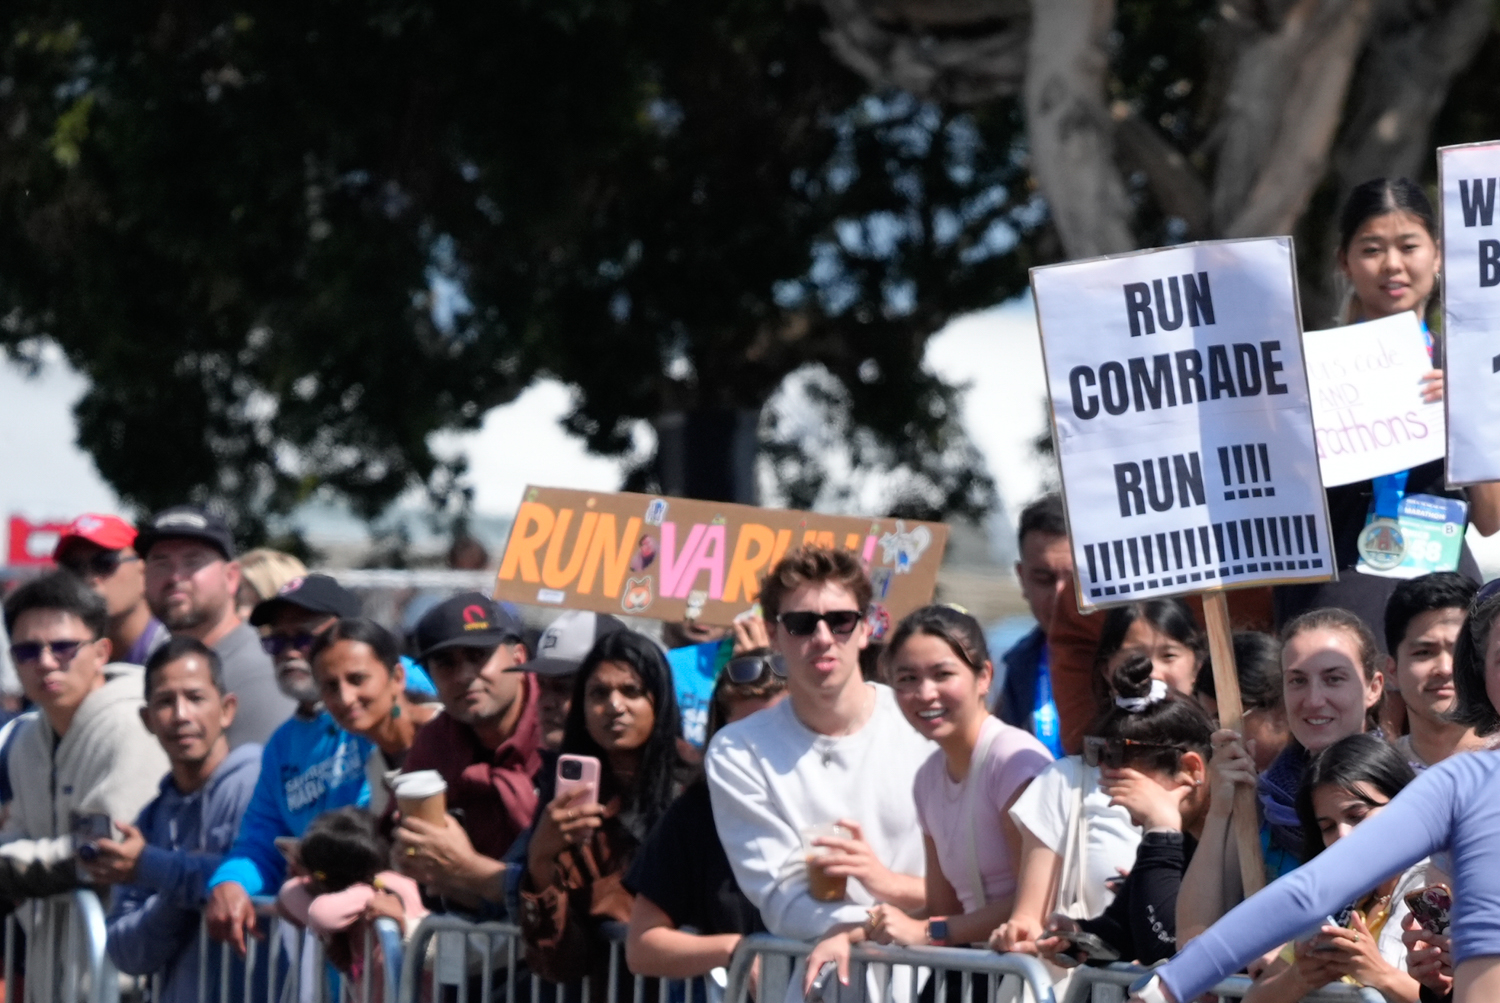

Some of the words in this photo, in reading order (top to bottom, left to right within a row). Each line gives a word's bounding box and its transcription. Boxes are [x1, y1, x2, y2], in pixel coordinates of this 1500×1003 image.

[1123, 271, 1216, 338] RUN
[1068, 340, 1289, 420] COMRADE
[1354, 338, 1404, 373] code
[1318, 383, 1361, 410] AND
[1113, 451, 1207, 518] RUN
[1216, 443, 1276, 501] !!!!
[499, 501, 642, 598] RUN
